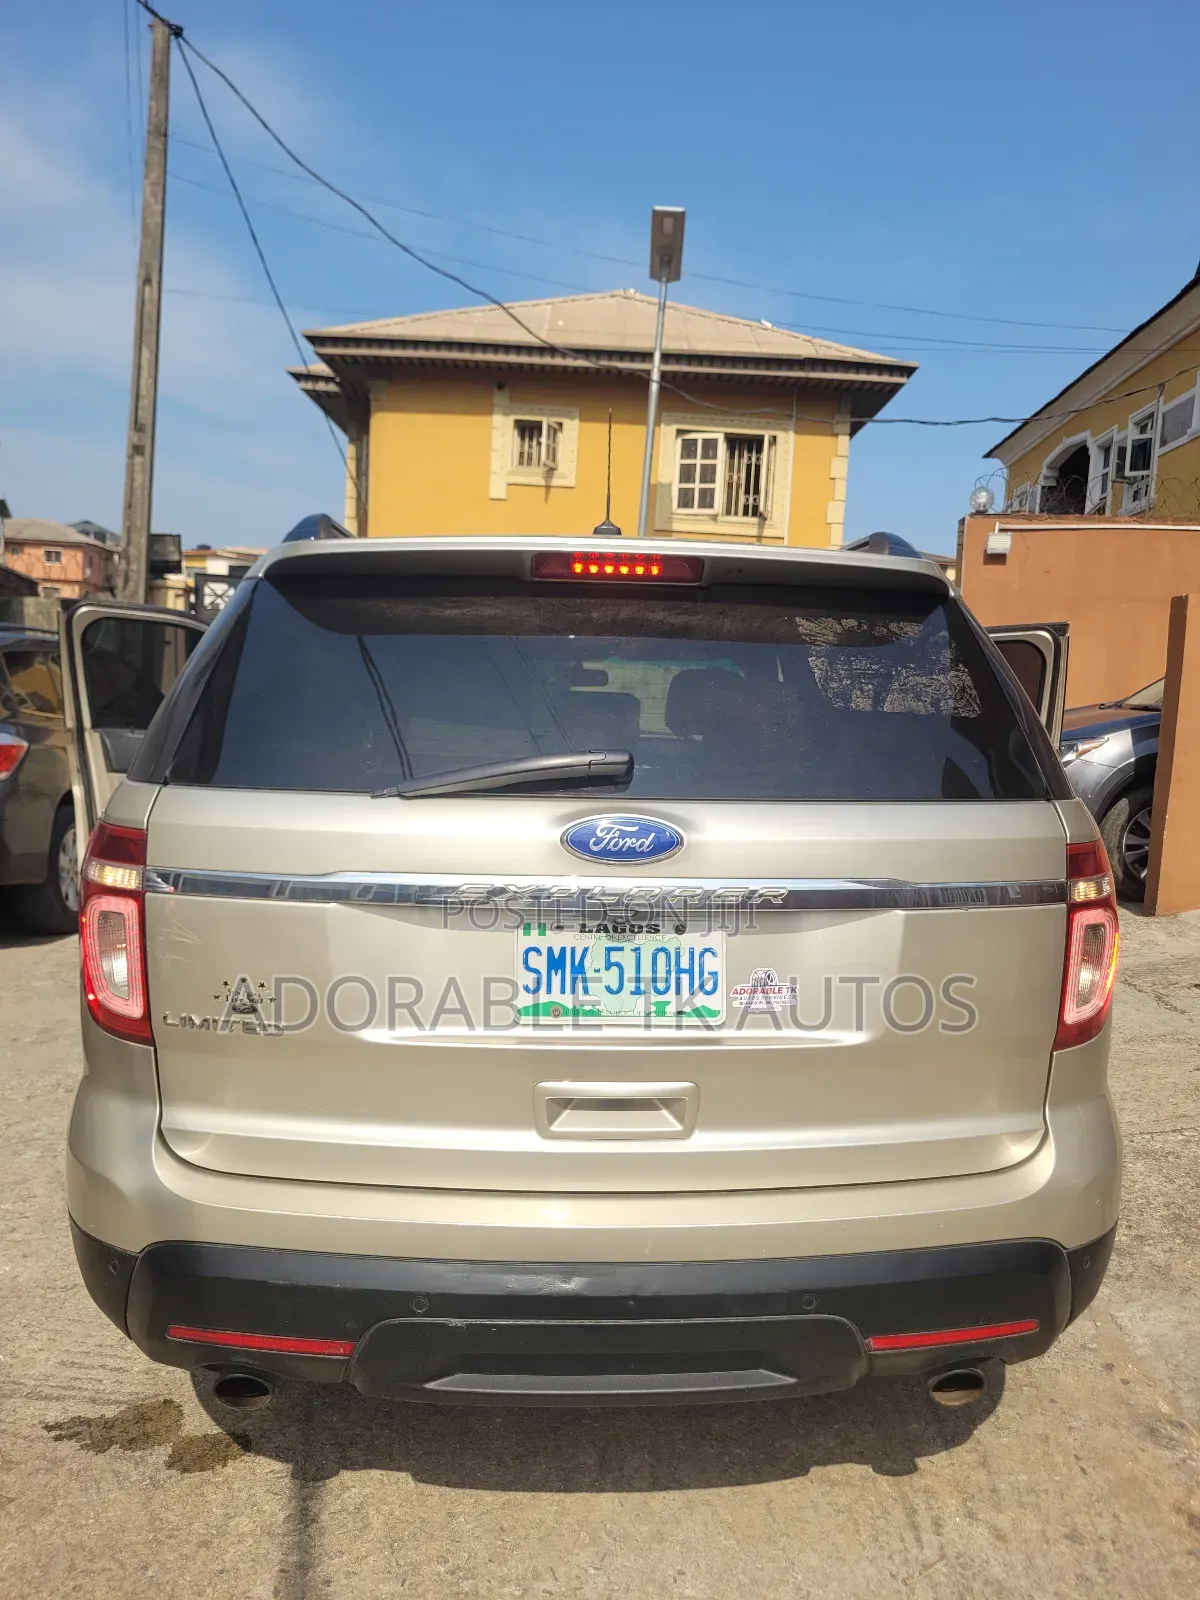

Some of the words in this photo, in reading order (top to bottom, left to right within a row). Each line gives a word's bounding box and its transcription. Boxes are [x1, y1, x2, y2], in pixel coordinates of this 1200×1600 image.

[588, 823, 656, 852] Ford
[452, 883, 789, 904] EXPLORER
[579, 923, 661, 934] LAGOS
[522, 945, 719, 996] SMK-510HG
[731, 987, 784, 996] ADORABLE
[786, 986, 798, 994] TK
[162, 1011, 284, 1037] LIMITED
